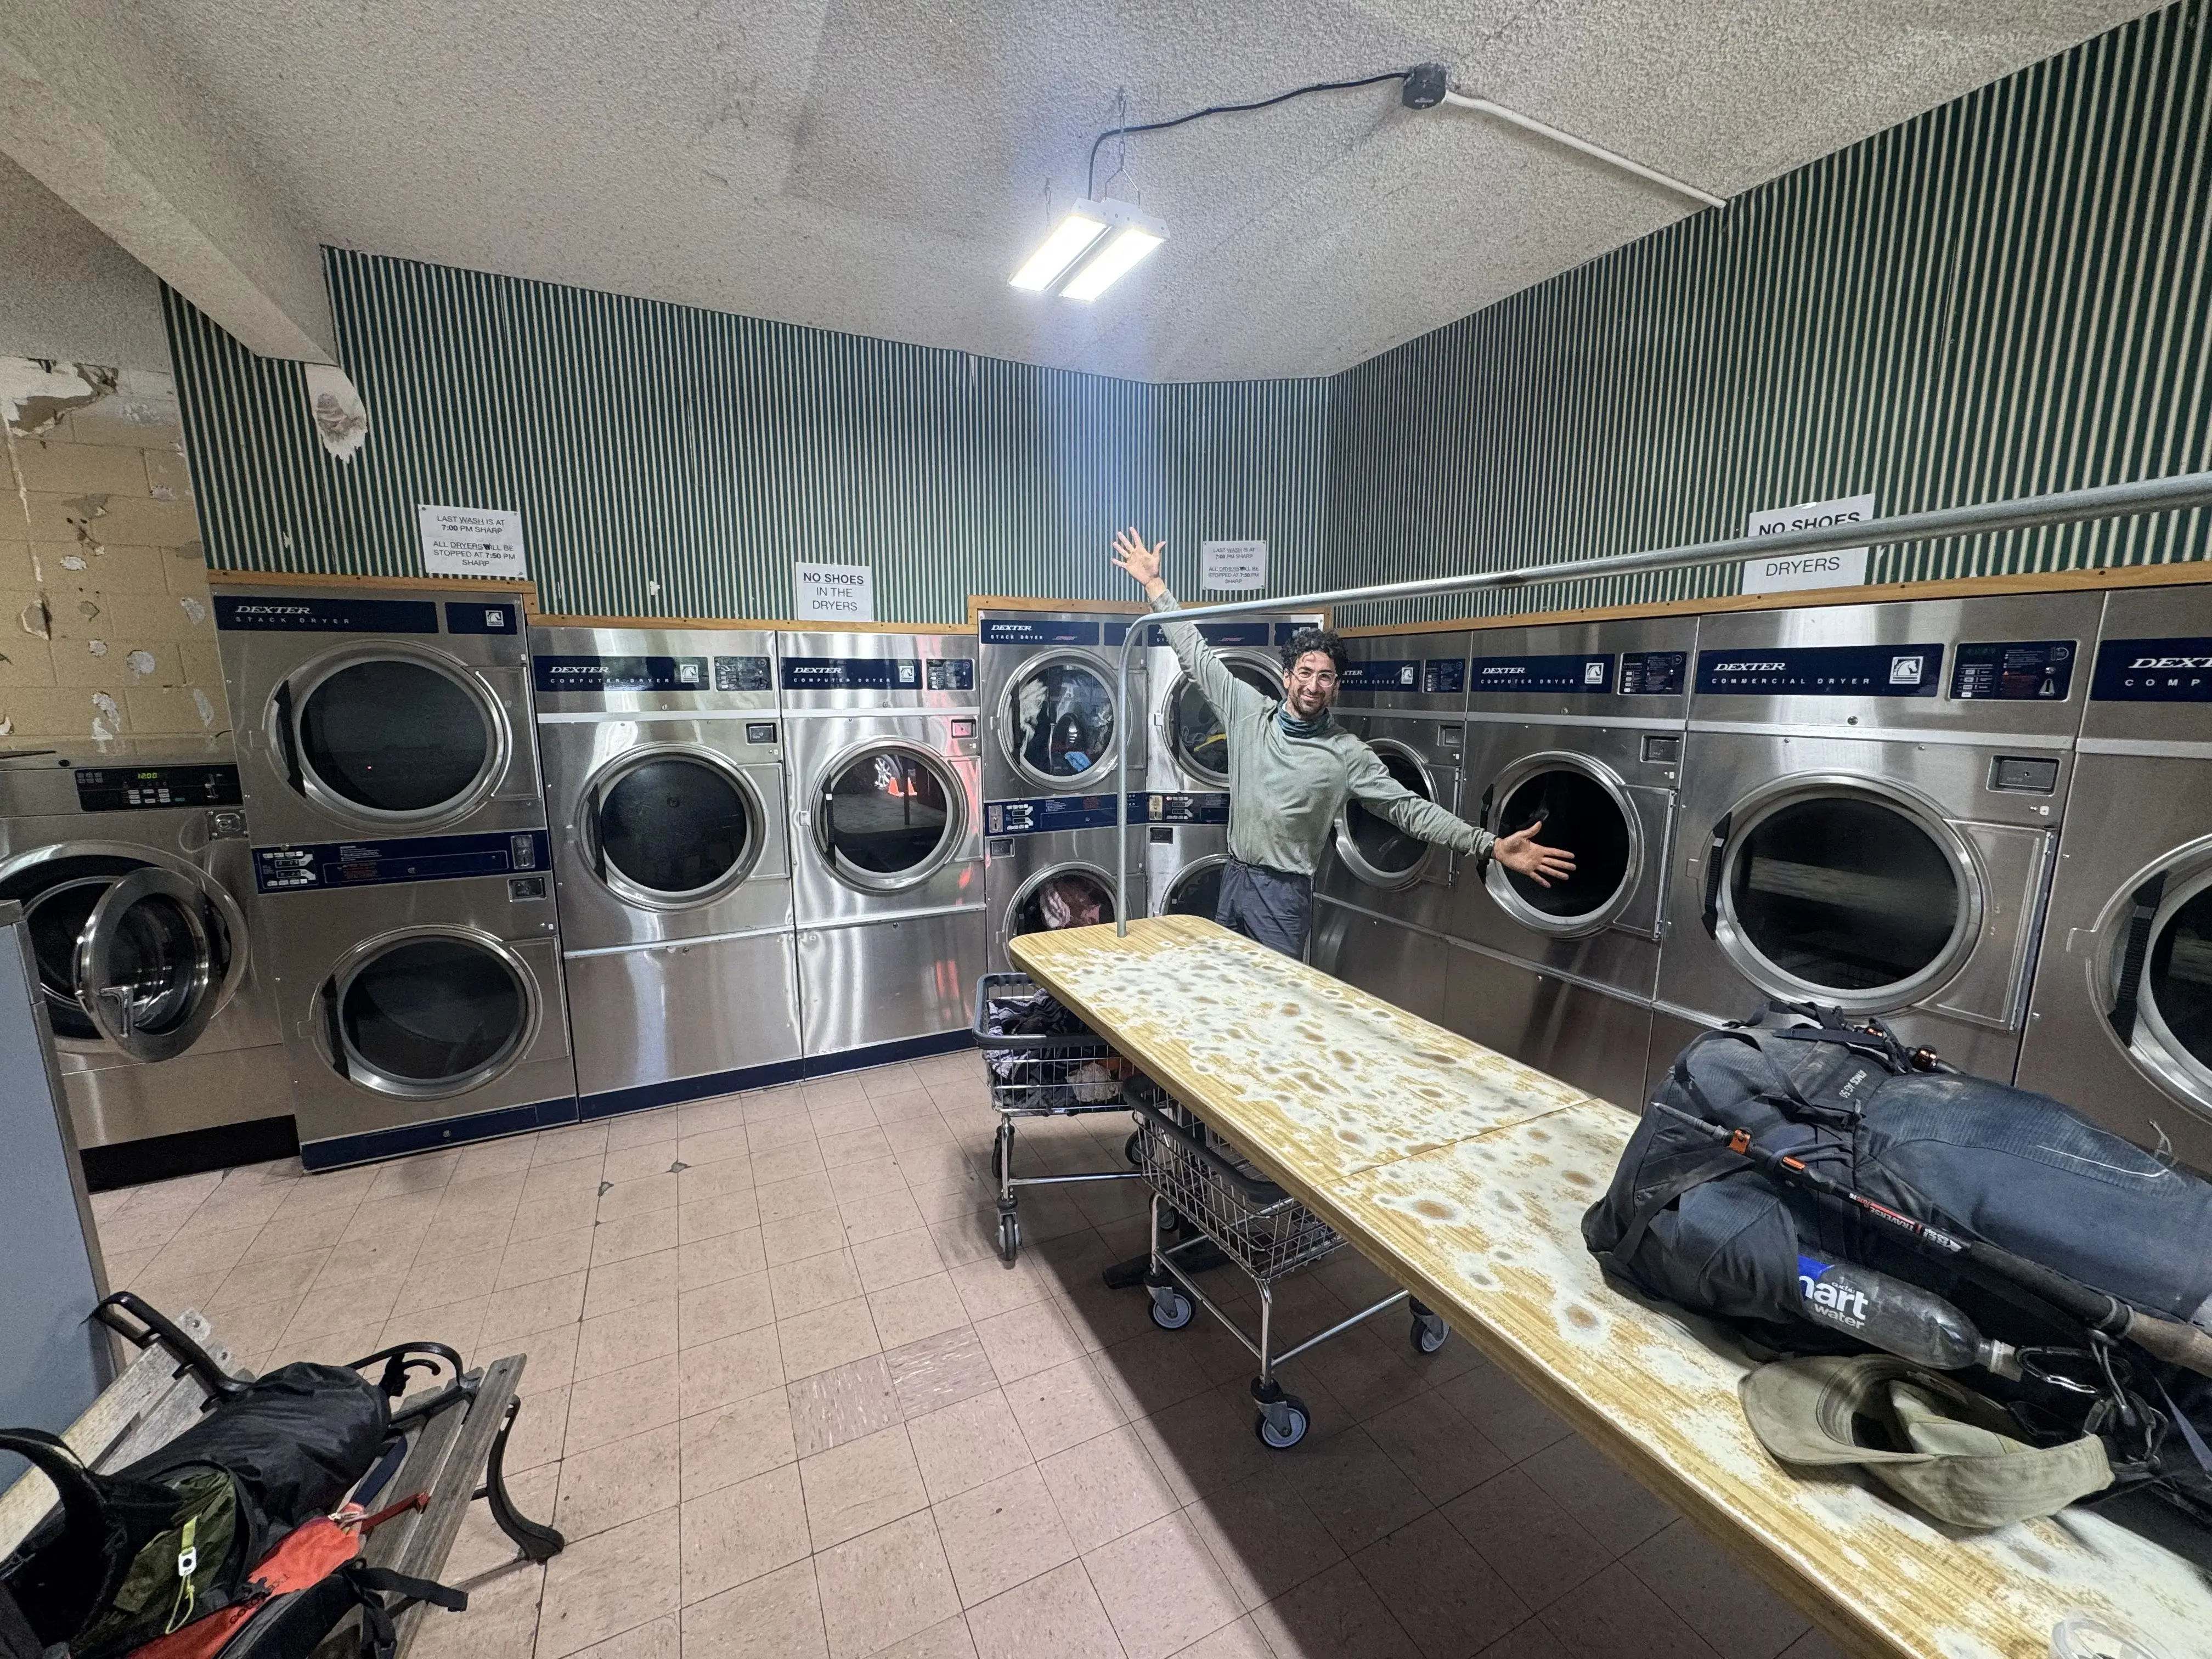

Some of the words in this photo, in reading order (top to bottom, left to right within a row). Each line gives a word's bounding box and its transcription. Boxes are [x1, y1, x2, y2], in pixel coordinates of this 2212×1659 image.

[459, 517, 484, 525] WASH
[1759, 522, 1785, 535] NO
[1791, 512, 1860, 531] SHOES
[450, 541, 483, 550] DRYERS
[433, 549, 472, 557] STOPPED
[1766, 557, 1840, 576] DRYERS
[803, 572, 821, 583] NO
[824, 573, 864, 585] SHOES
[816, 586, 827, 596] IN
[831, 587, 853, 597] THE
[235, 606, 311, 614] DEXTER
[812, 600, 858, 611] DRYERS
[1713, 663, 1786, 671] DEXTER
[1870, 1206, 1914, 1232] TRAVERSE
[1923, 1232, 1948, 1247] REI
[1814, 1303, 1865, 1329] water
